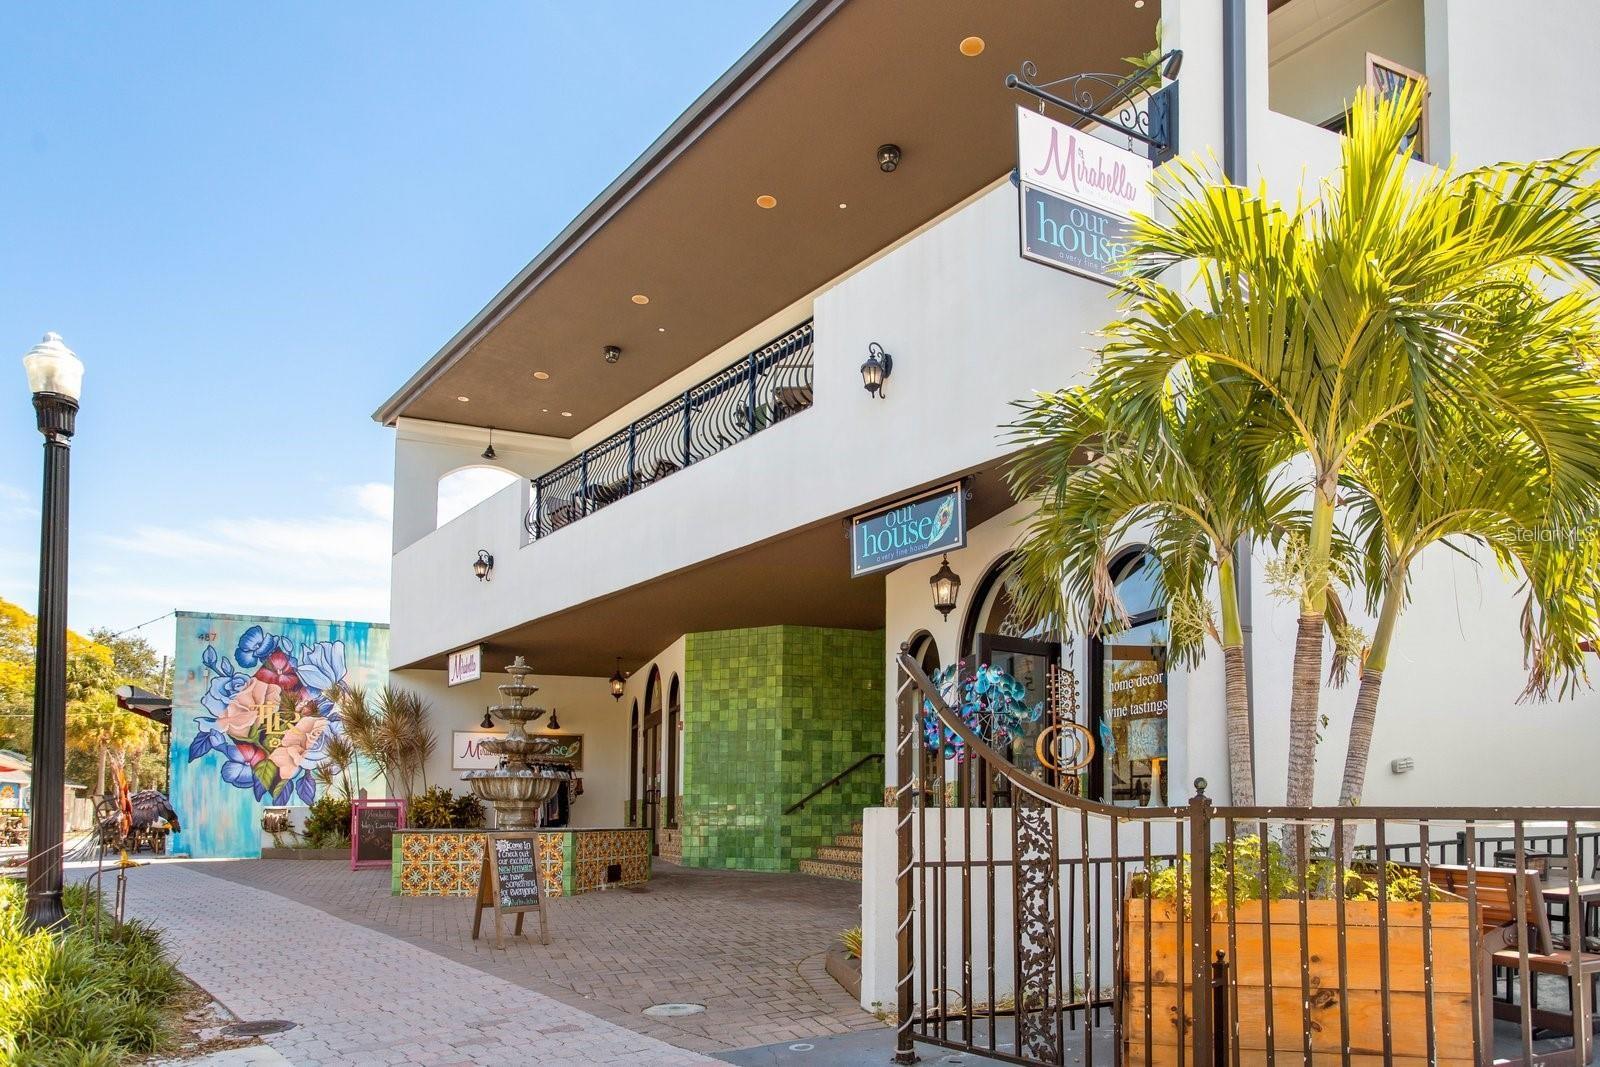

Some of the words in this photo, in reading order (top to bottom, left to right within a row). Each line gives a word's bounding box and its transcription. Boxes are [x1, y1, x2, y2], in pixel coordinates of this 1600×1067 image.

[1033, 126, 1137, 201] Mirabella
[1037, 201, 1127, 264] house
[1069, 208, 1109, 234] our
[885, 503, 916, 528] our
[861, 516, 933, 558] house
[882, 552, 895, 561] very
[896, 548, 908, 557] fine
[909, 543, 929, 552] house
[1108, 679, 1134, 693] home
[1136, 672, 1164, 687] decor
[1105, 703, 1128, 718] wine
[1130, 698, 1169, 715] tastings
